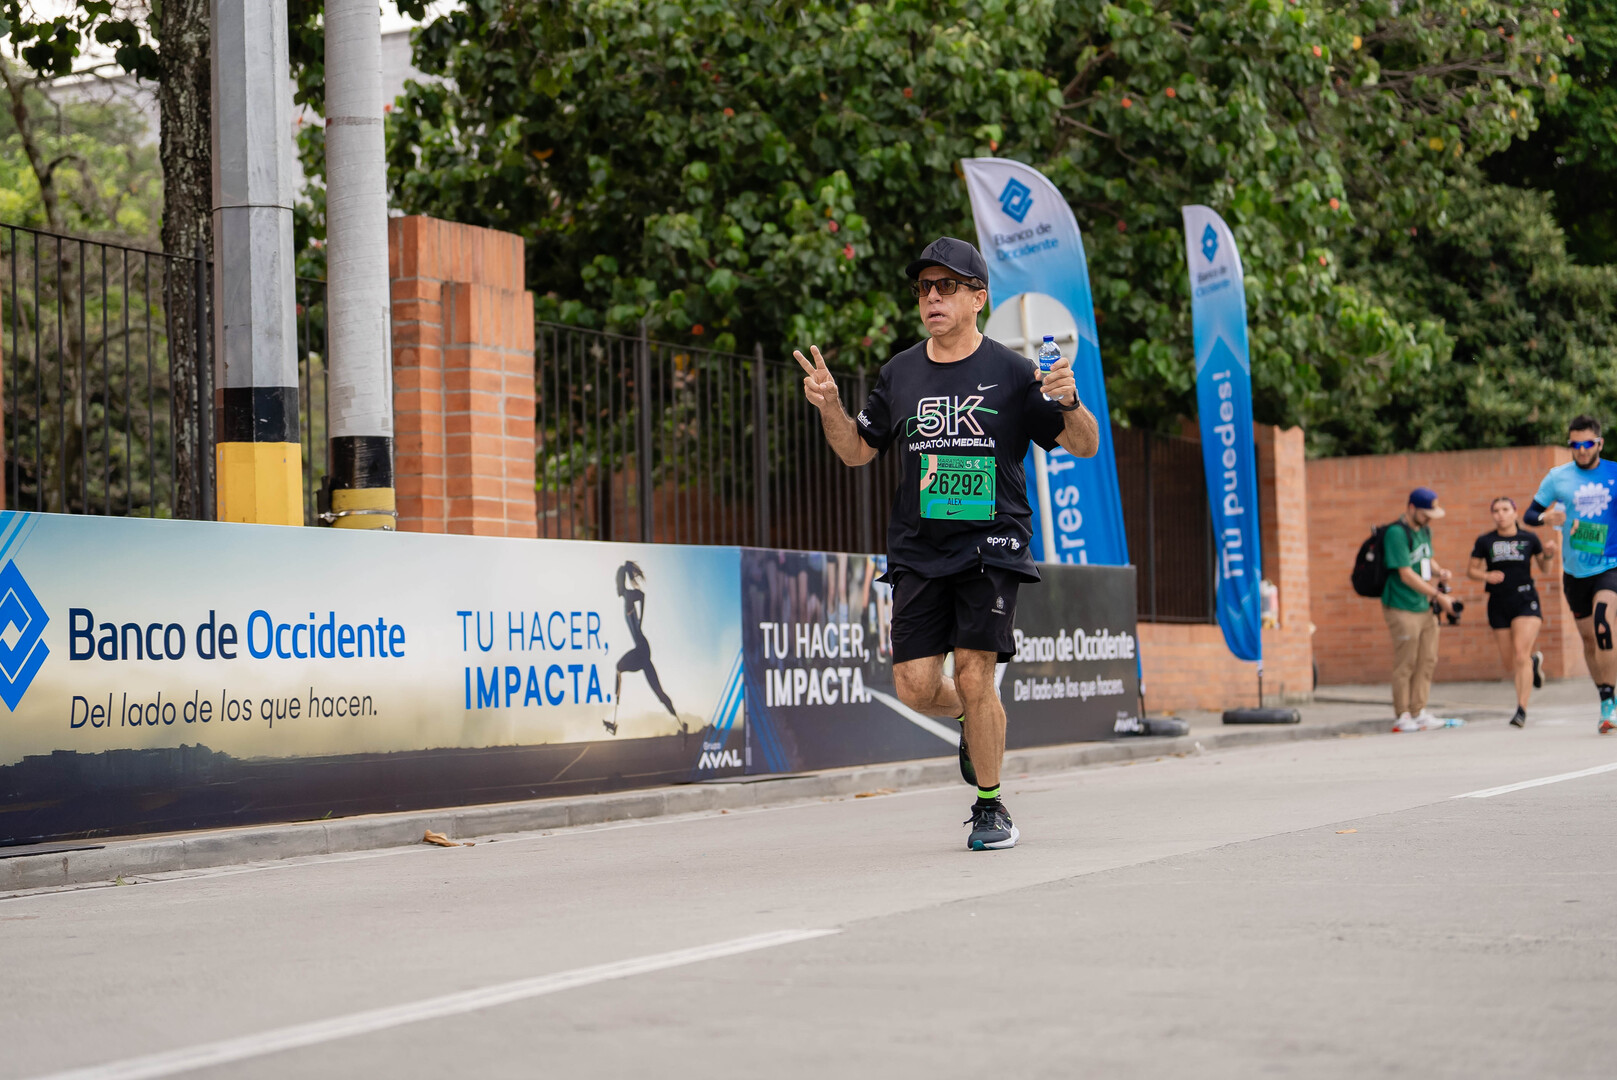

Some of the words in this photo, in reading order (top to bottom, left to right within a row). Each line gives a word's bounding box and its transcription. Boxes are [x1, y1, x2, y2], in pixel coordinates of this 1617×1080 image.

[995, 229, 1034, 247] Banco
[1036, 222, 1052, 236] de
[996, 238, 1059, 262] Occidente
[909, 437, 950, 451] MARATÓN
[952, 437, 995, 448] MEDELLÍN
[1212, 369, 1245, 517] puedes!
[928, 472, 983, 496] 26292
[947, 497, 962, 506] ALEX
[69, 608, 186, 661] Banco
[196, 610, 238, 660] de
[247, 609, 405, 659] Occidente
[456, 611, 494, 652] TU
[508, 611, 609, 656] HACER,
[759, 622, 789, 659] TU
[795, 622, 870, 663] HACER,
[1013, 629, 1055, 662] Banco
[1056, 629, 1073, 662] de
[1073, 628, 1135, 661] Occidente
[465, 664, 611, 710] IMPACTA.
[765, 666, 872, 707] IMPACTA.
[1014, 678, 1031, 701] Del
[1031, 677, 1052, 700] lado
[1053, 676, 1065, 699] de
[1065, 675, 1079, 698] los
[1080, 680, 1096, 702] que
[1096, 674, 1125, 696] hacen.
[70, 692, 112, 728] Del
[121, 691, 176, 726] lado
[184, 689, 212, 723] de
[221, 689, 252, 721] los
[260, 697, 300, 728] que
[309, 686, 377, 718] hacen.
[698, 749, 742, 770] AVAL
